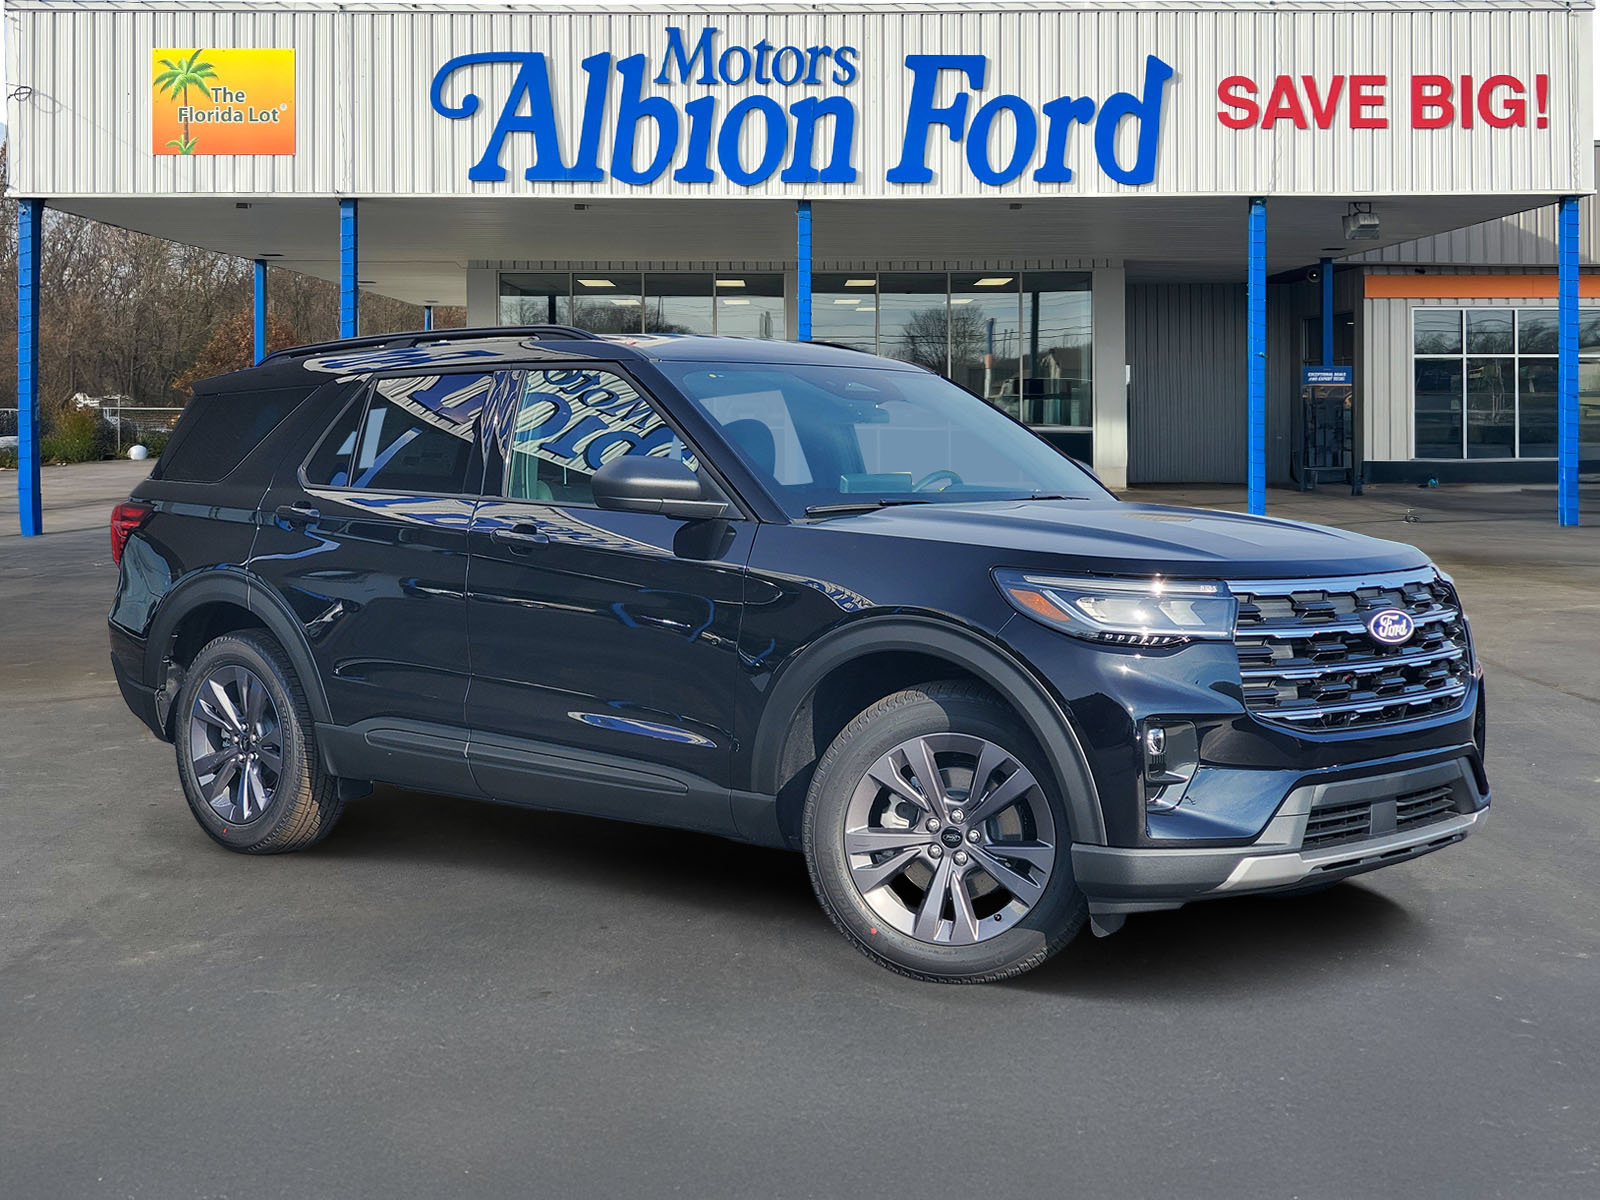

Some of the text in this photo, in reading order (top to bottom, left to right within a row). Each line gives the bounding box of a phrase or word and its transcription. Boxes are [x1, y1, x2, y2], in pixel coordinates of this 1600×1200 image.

[653, 26, 858, 86] Motors
[178, 107, 243, 122] Florida
[211, 87, 245, 103] The
[1217, 74, 1548, 129] SAVE BIG!
[430, 51, 1174, 186] Albion Ford
[1378, 614, 1408, 638] Ford
